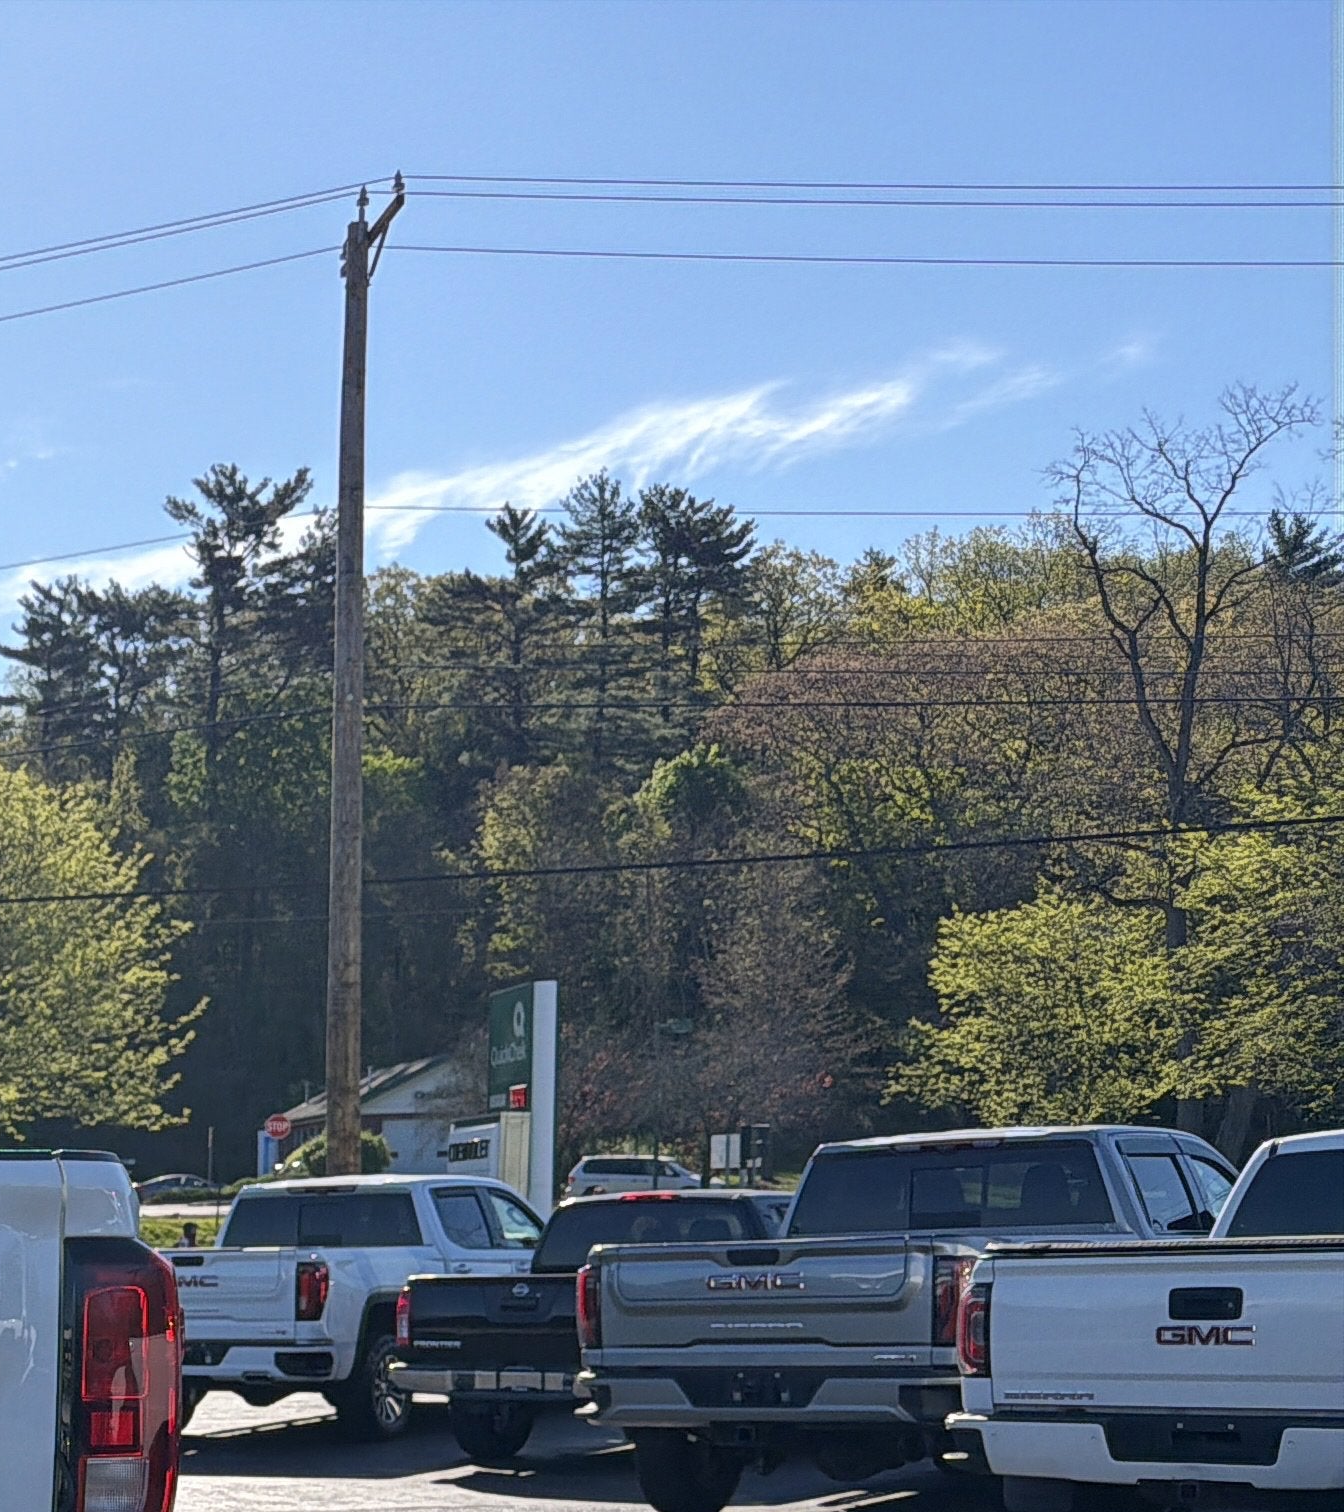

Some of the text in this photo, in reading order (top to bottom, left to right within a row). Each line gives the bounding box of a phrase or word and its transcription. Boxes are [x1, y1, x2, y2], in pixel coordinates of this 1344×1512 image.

[266, 1120, 289, 1132] STOP
[178, 1275, 218, 1287] MC
[706, 1271, 804, 1291] GMC
[1155, 1325, 1256, 1346] GMC
